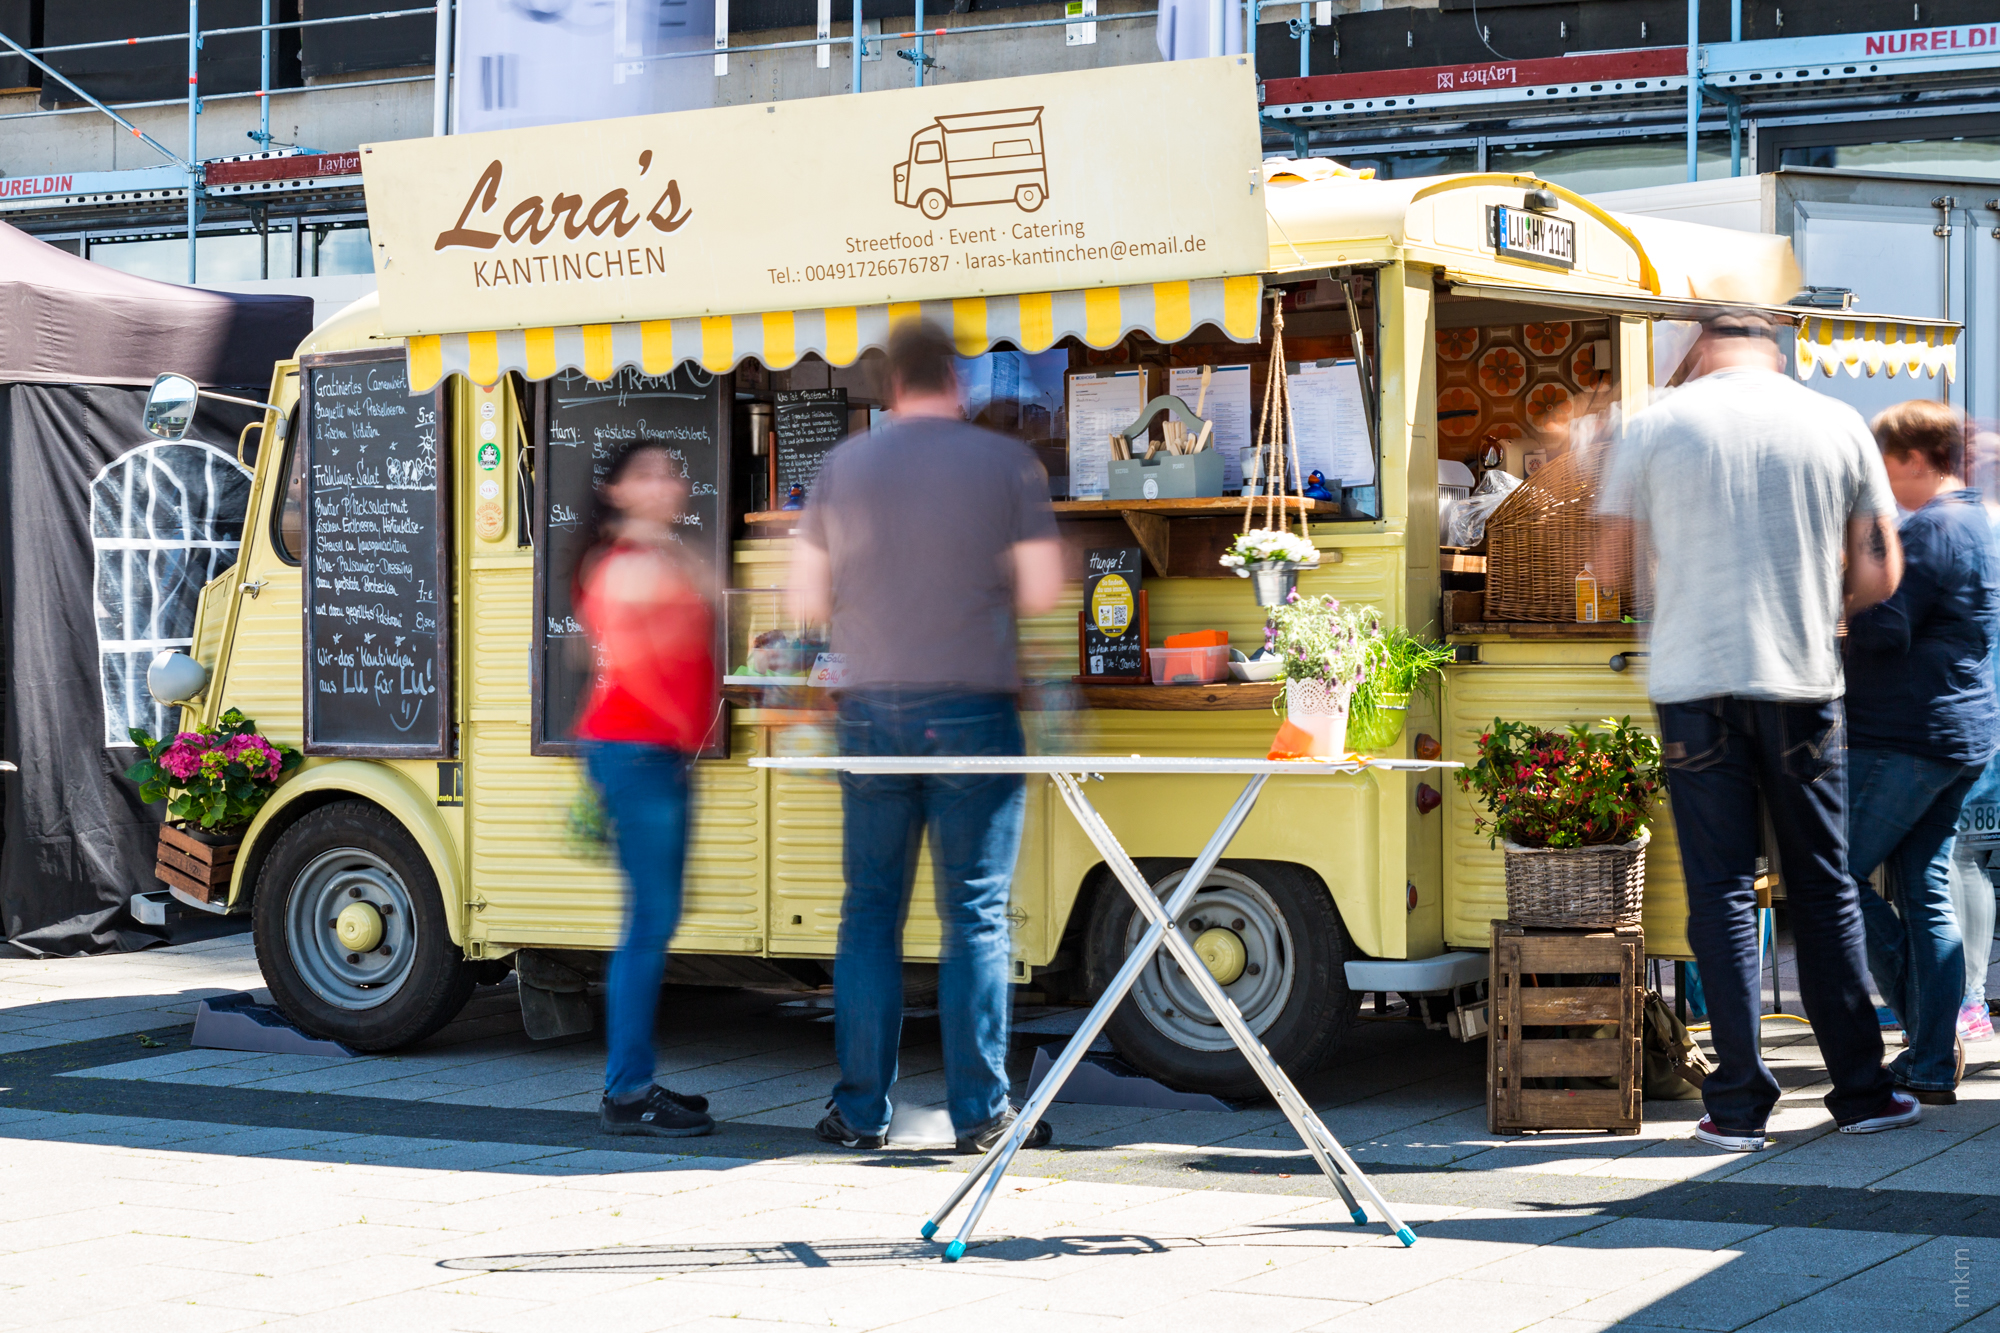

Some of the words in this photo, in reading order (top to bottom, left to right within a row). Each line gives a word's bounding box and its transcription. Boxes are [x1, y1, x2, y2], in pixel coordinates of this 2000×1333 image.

[1460, 65, 1517, 86] Layher
[318, 153, 360, 174] Layher
[434, 149, 693, 251] Lara's
[845, 229, 934, 253] Streetfood
[949, 226, 997, 246] Event
[1011, 219, 1086, 240] Catering
[1508, 214, 1524, 248] LU
[1532, 218, 1546, 252] HY
[1548, 223, 1572, 259] 111H
[474, 246, 665, 288] KANTINCHEN
[767, 266, 801, 285] Tel.:
[805, 255, 950, 283] 00491726676787
[965, 234, 1207, 269] laras-kantinchen@email.de
[315, 373, 362, 397] Gratiniertes
[347, 407, 362, 417] mit
[550, 420, 580, 447] Harry:
[315, 496, 340, 518] Bunter
[341, 492, 390, 519] Pflücksalat
[391, 498, 409, 514] mit
[346, 541, 356, 551] an
[1089, 550, 1126, 574] Hunger?
[824, 653, 845, 664] Sala
[319, 679, 337, 694] aus
[343, 668, 368, 695] LU
[374, 670, 394, 707] für
[818, 668, 840, 684] Sally
[1975, 806, 2000, 831] 88
